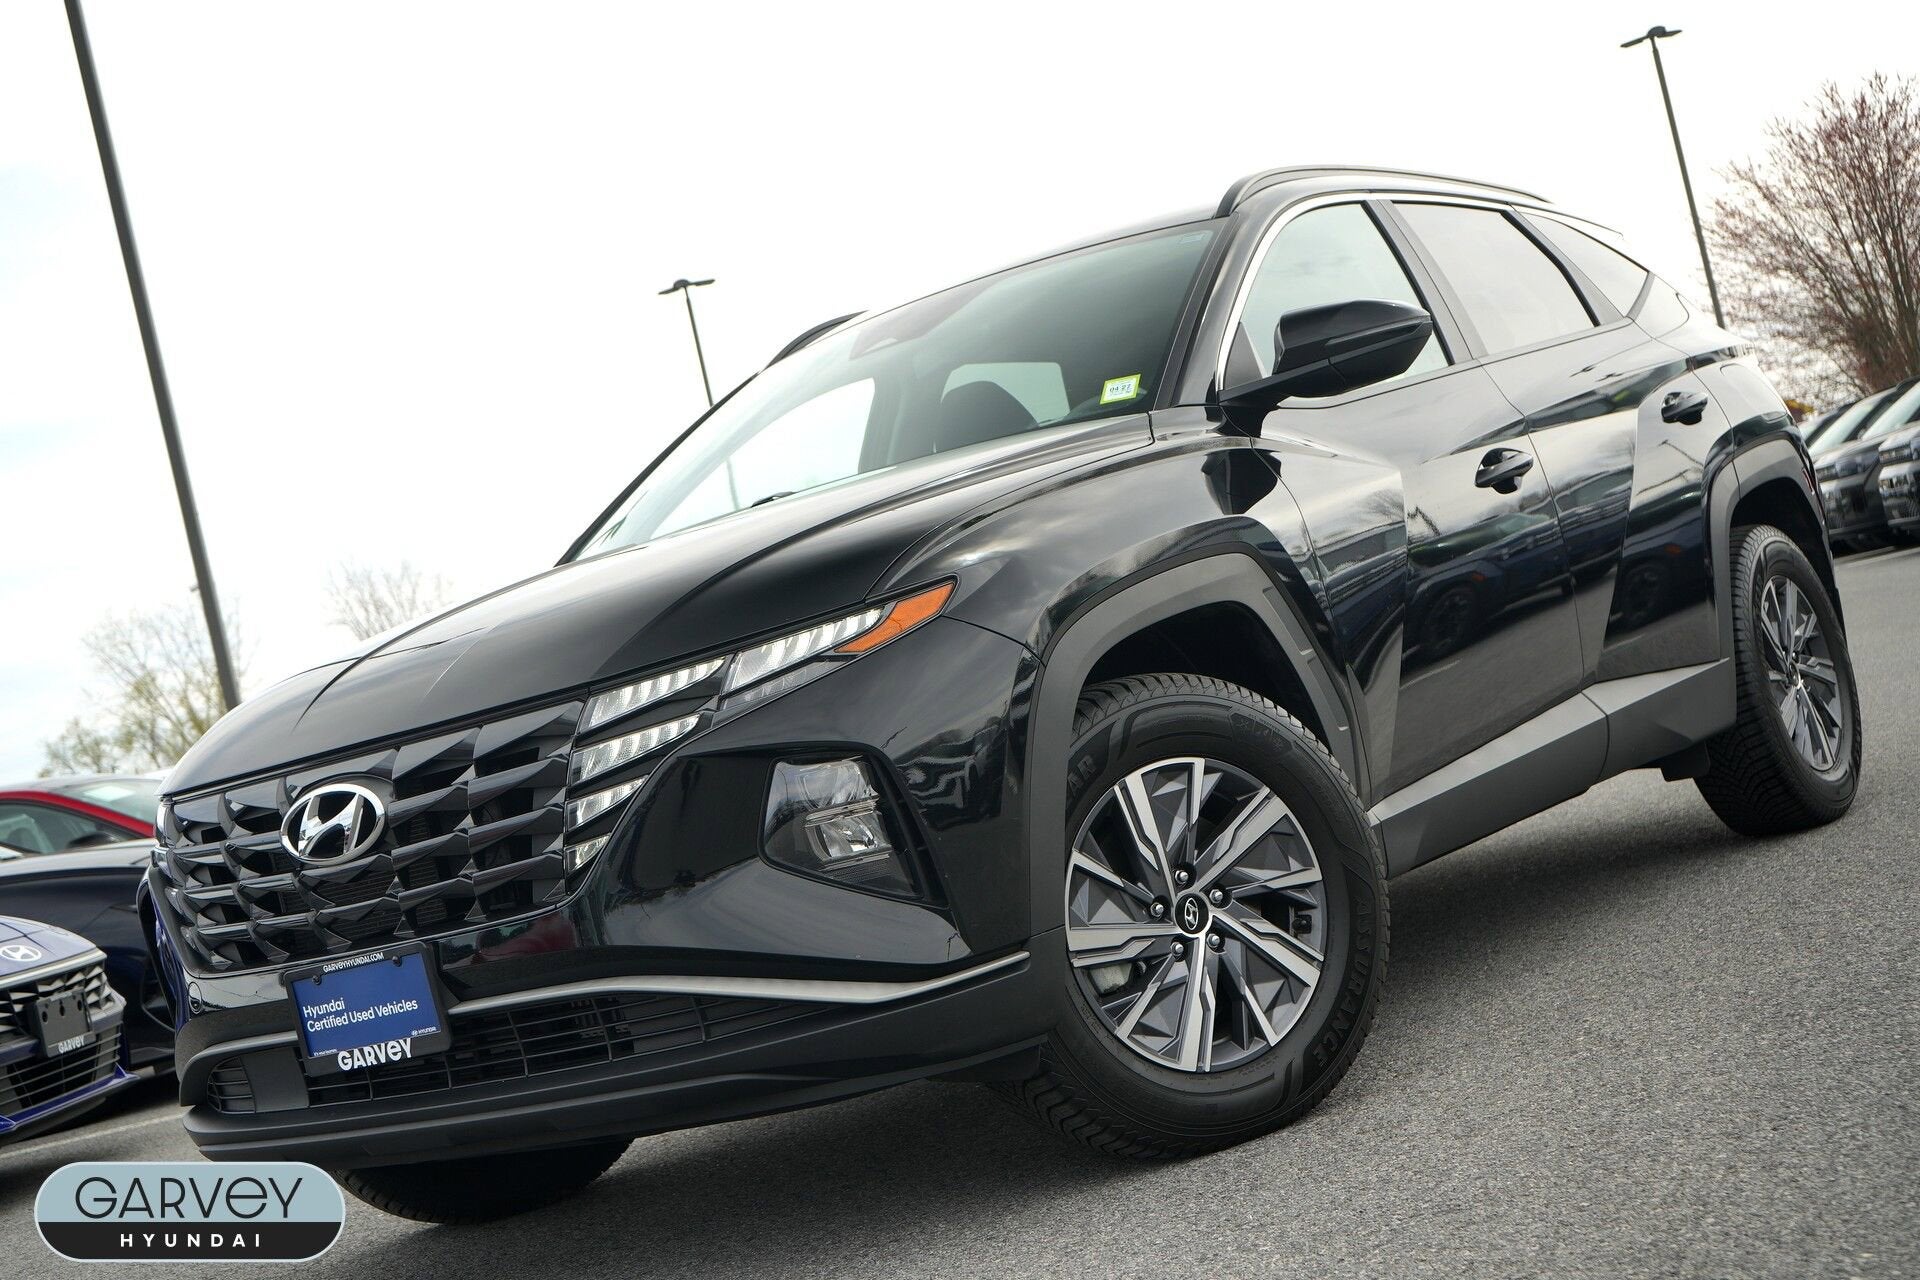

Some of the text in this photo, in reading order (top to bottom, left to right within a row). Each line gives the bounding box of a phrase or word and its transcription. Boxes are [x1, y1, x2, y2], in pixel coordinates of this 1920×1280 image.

[302, 997, 346, 1018] Hyundai
[307, 999, 418, 1033] Certified Used Vehicles
